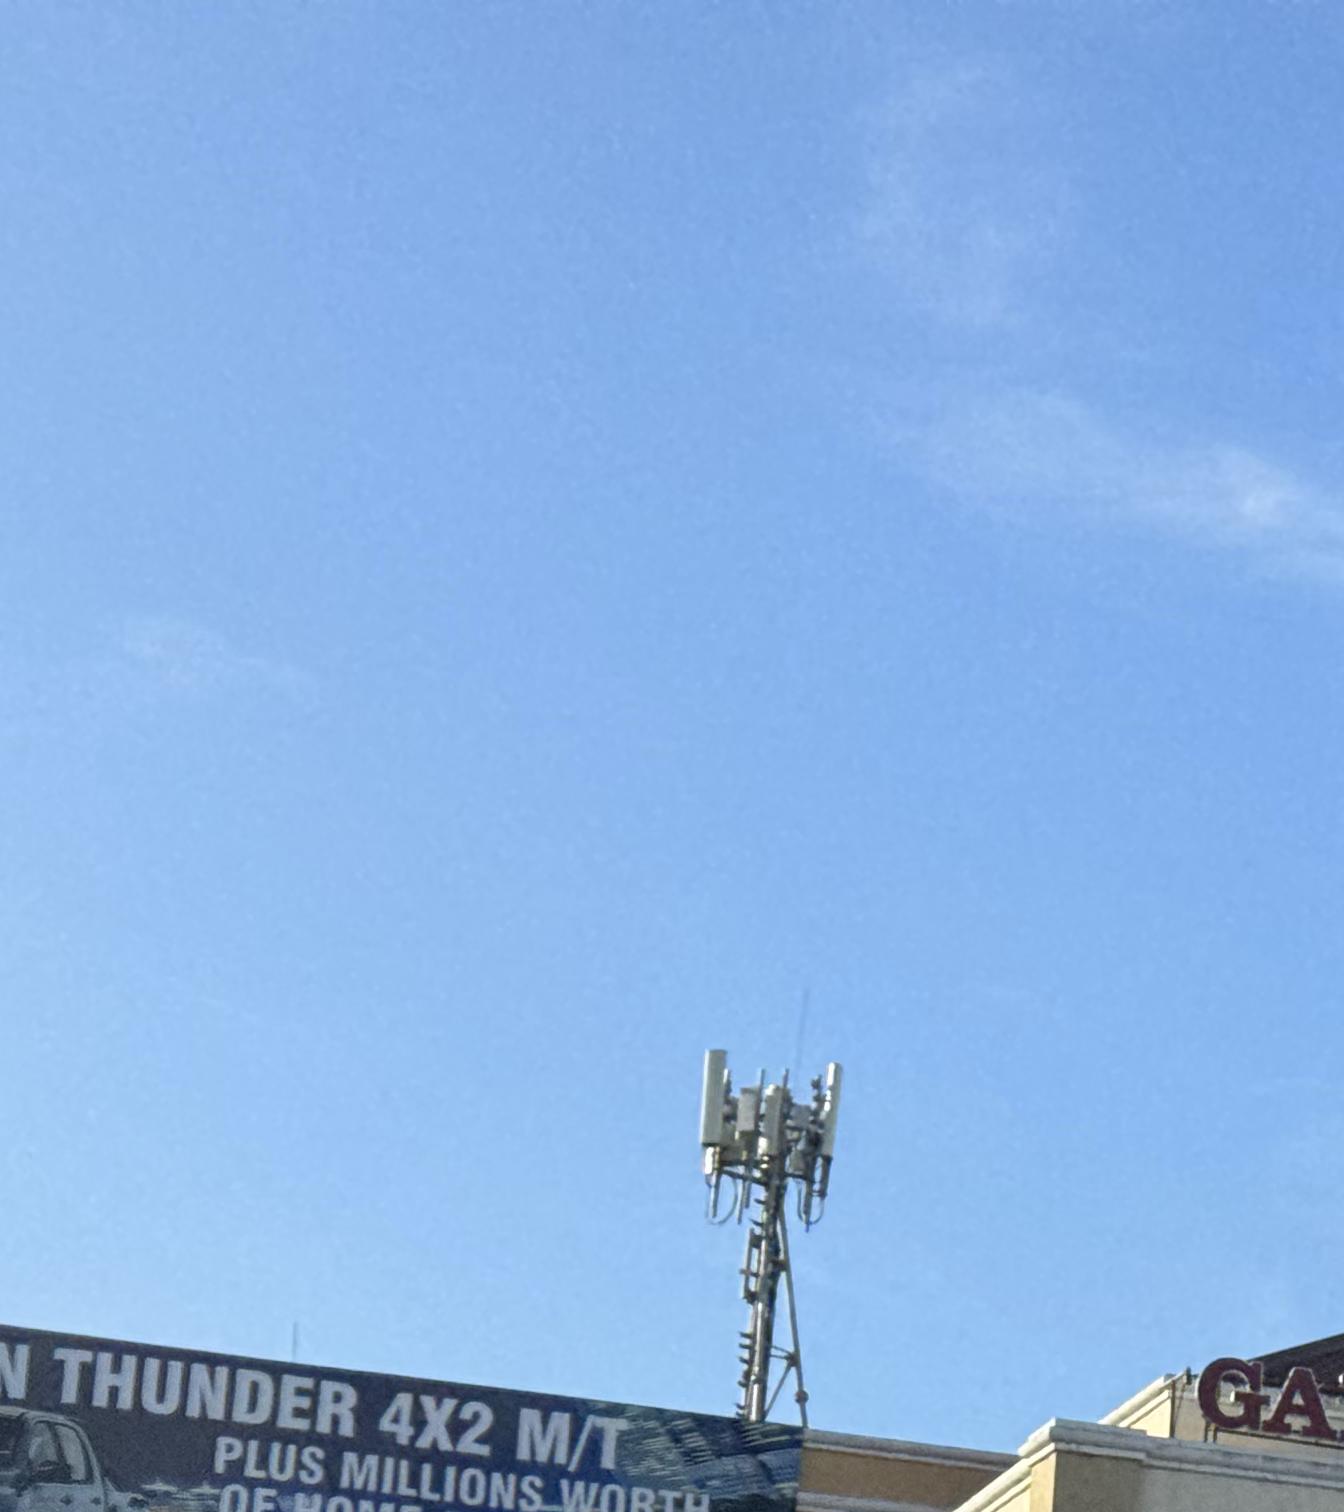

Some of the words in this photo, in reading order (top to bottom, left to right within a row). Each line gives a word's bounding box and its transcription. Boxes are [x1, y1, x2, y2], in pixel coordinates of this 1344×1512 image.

[54, 1348, 358, 1437] THUNDER
[379, 1392, 494, 1456] 4X2
[516, 1407, 629, 1472] M/T
[214, 1436, 325, 1485] PLUS
[339, 1451, 544, 1512] MILLIONS
